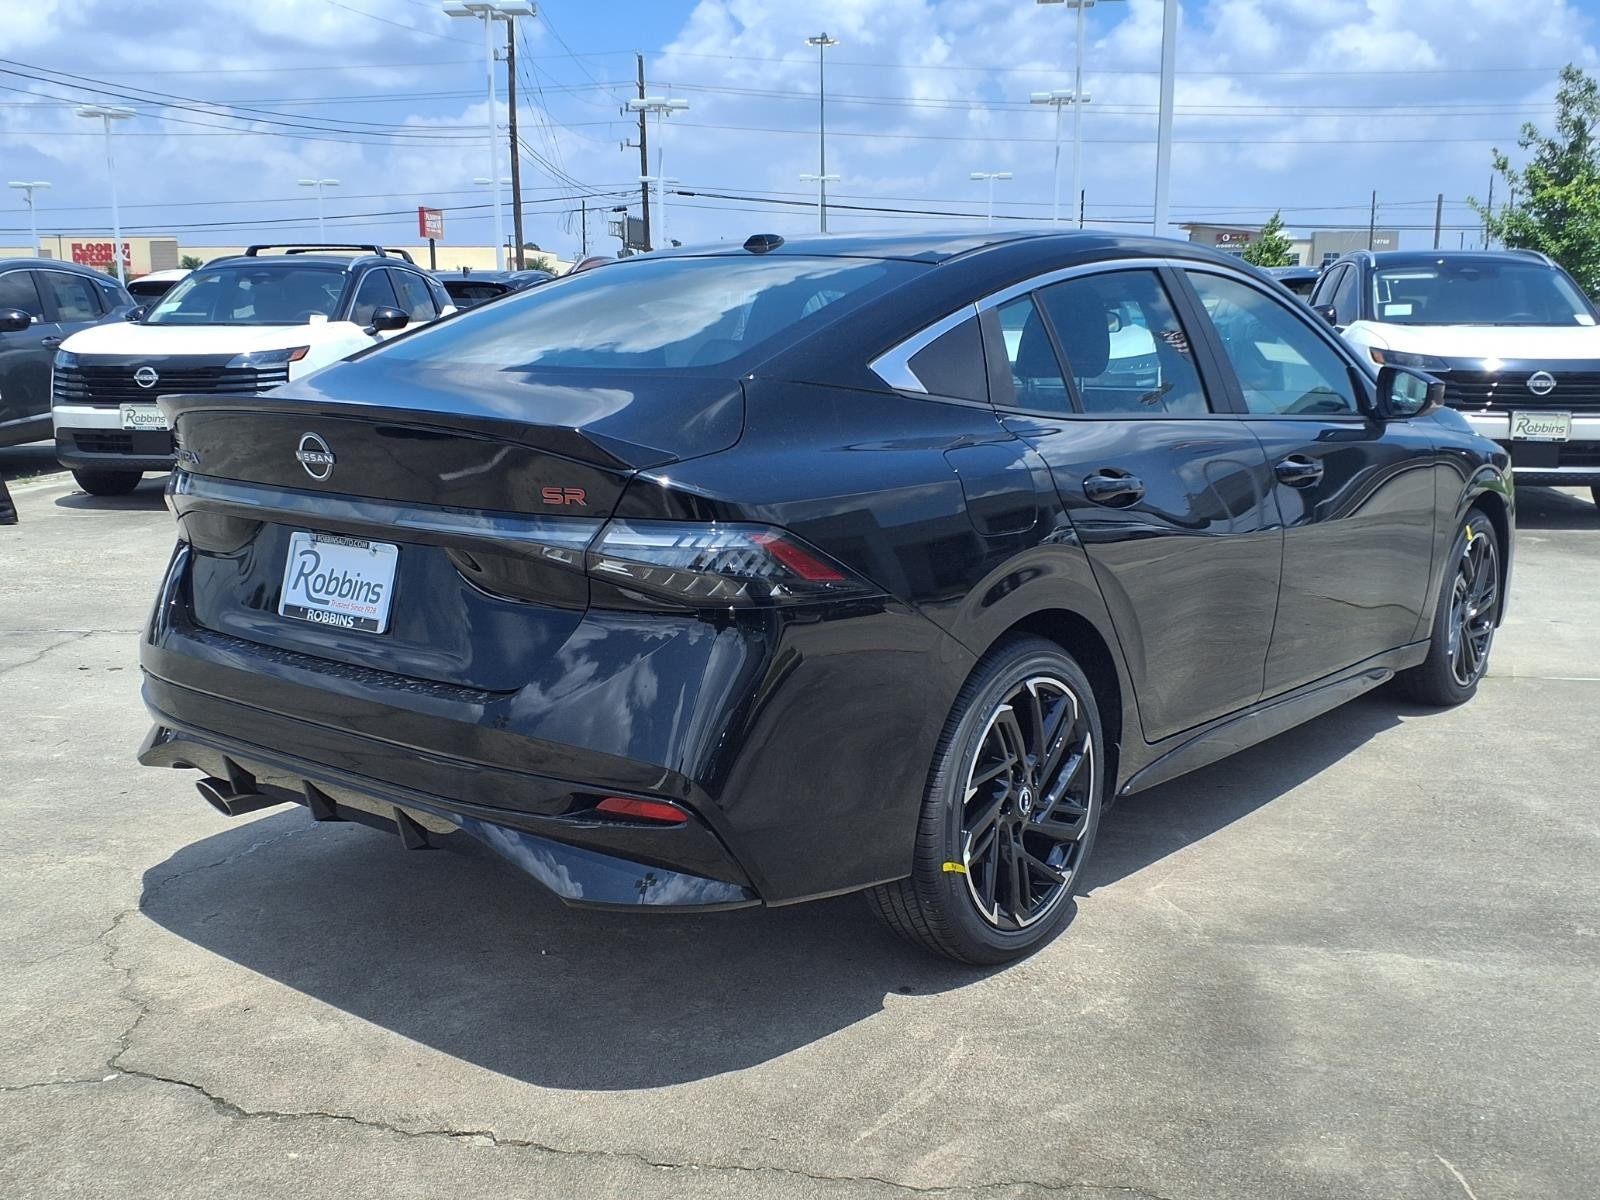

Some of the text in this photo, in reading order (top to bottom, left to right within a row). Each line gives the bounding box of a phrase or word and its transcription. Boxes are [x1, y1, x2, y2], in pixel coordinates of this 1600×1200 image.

[72, 242, 112, 252] FLOOR
[124, 408, 166, 425] Robbins
[1515, 417, 1566, 435] Robbins
[295, 450, 334, 464] NISSAN
[542, 487, 588, 506] SR
[292, 549, 384, 605] Robbins
[331, 599, 350, 609] Trusted
[350, 602, 365, 612] Since
[306, 609, 355, 628] ROBBINS
